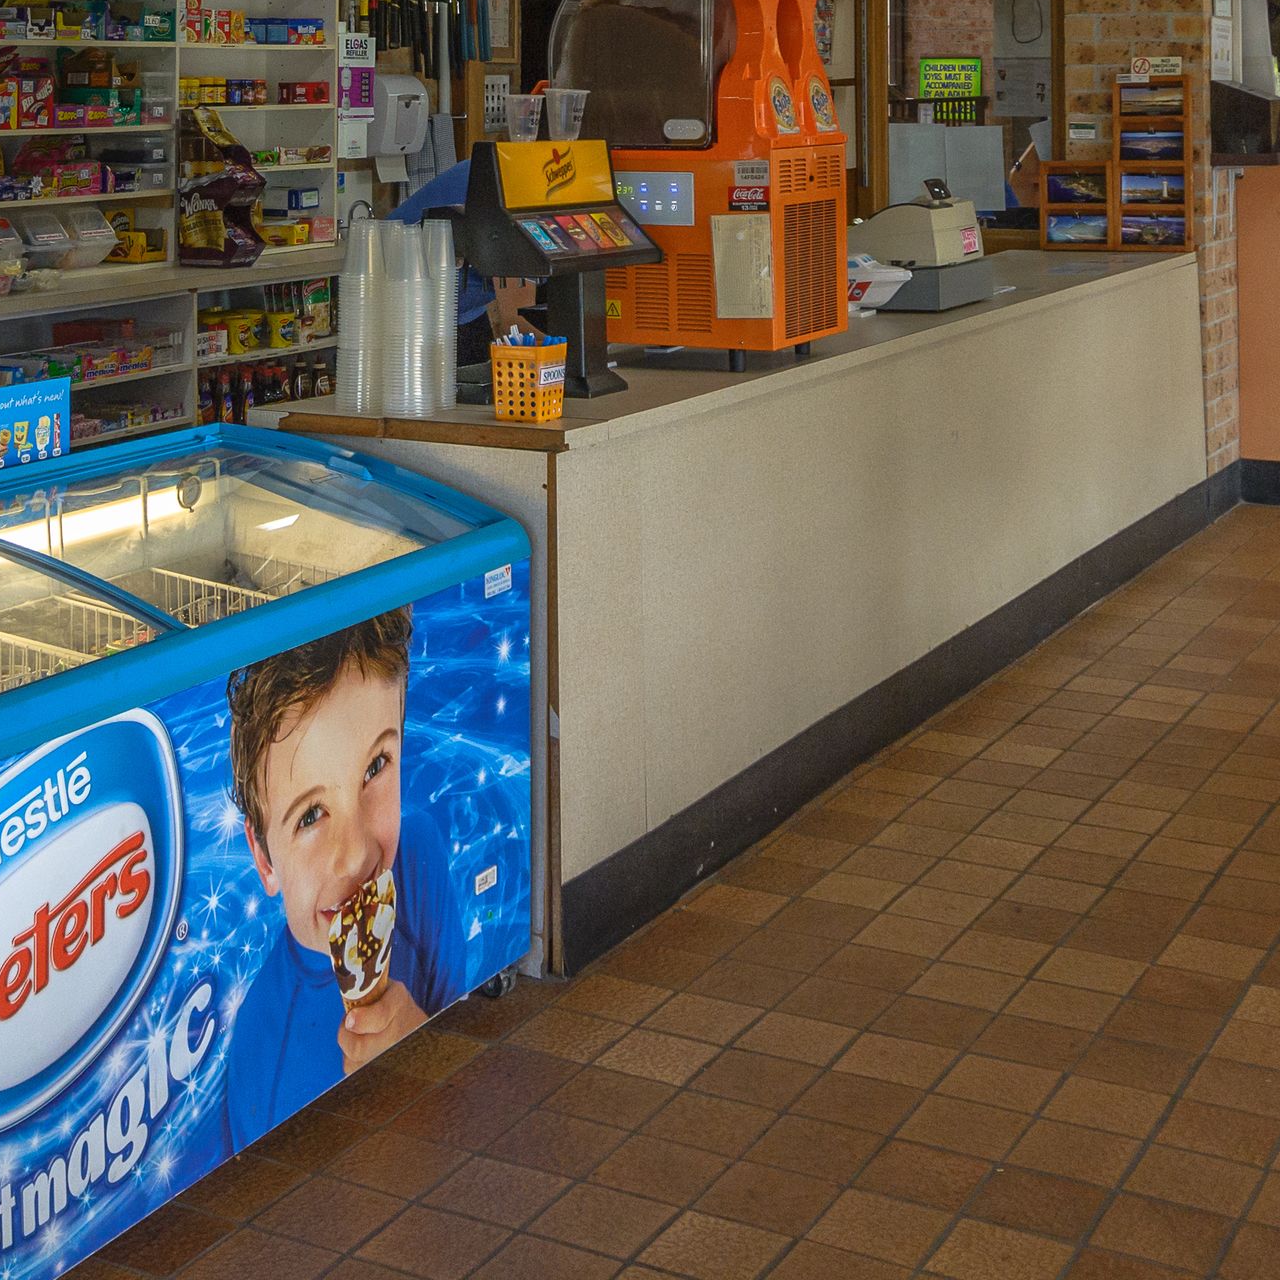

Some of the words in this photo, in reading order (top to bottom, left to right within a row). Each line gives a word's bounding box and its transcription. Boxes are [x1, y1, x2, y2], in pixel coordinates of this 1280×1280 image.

[345, 39, 368, 50] ELGAS
[346, 49, 368, 57] REFILLER
[924, 64, 956, 72] CHILDREN
[958, 64, 978, 72] UNDER
[964, 73, 972, 81] BE
[926, 82, 973, 90] ACCOMPANIED
[22, 96, 34, 112] RED
[36, 79, 53, 101] SKINS
[546, 160, 574, 187] Schweppes
[120, 362, 148, 372] mentos
[86, 368, 116, 378] mentos
[0, 399, 14, 410] out
[15, 391, 42, 407] what's
[44, 389, 65, 401] new!
[22, 982, 215, 1238] magic
